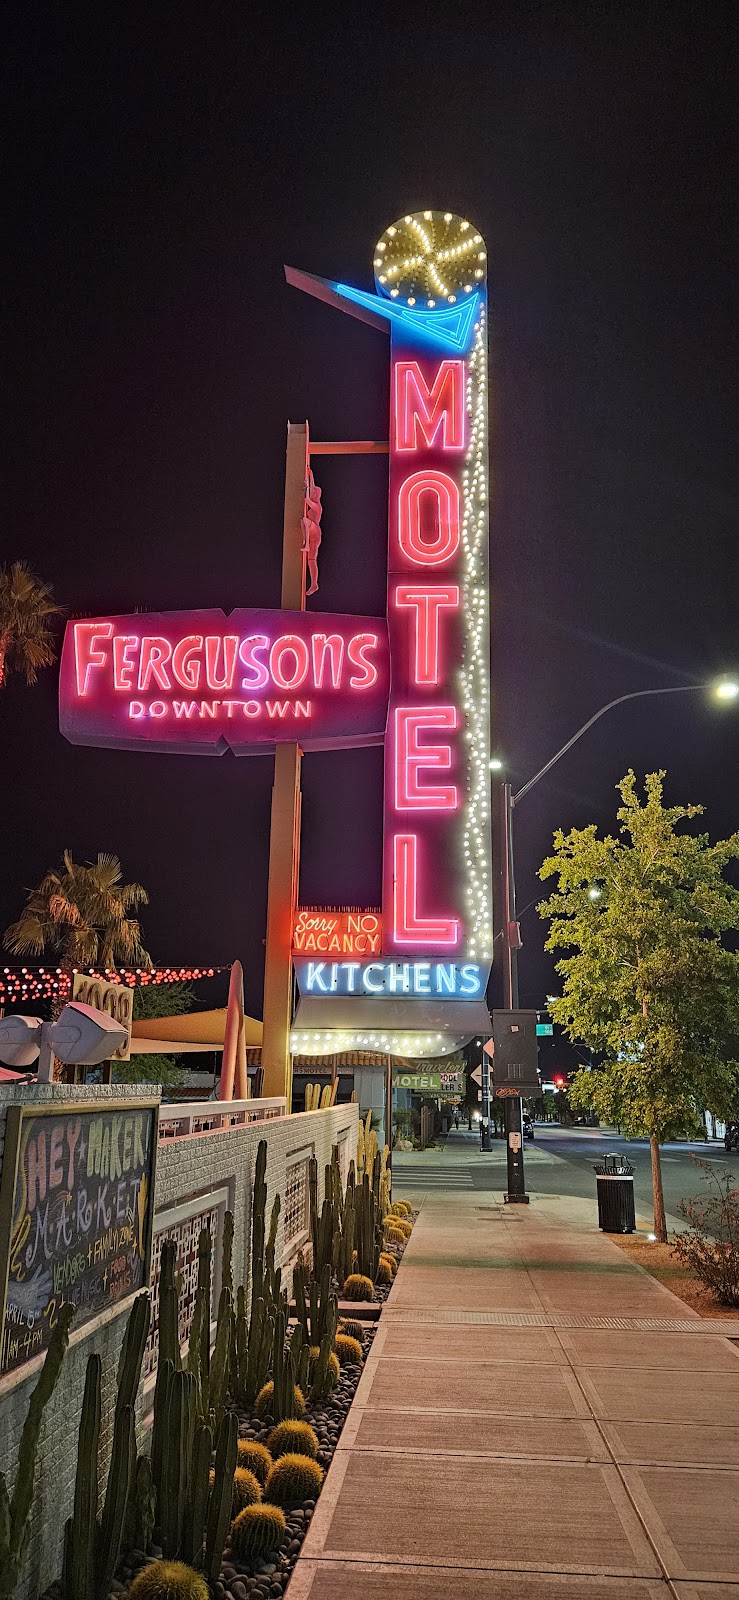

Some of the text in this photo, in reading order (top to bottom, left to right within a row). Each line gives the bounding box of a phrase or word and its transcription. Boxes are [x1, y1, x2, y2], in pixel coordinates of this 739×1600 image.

[73, 622, 378, 697] FERGUSONS
[394, 360, 466, 945] MOTEL
[128, 699, 312, 719] DOWNTOWN
[295, 912, 378, 935] Sorry NO
[293, 932, 380, 953] VACANCY
[305, 961, 481, 994] KITCHENS
[391, 1076, 437, 1088] MOTEL
[27, 1114, 146, 1212] HEY MAKER
[53, 1254, 86, 1295] VENDORS
[5, 1302, 25, 1326] APRIL
